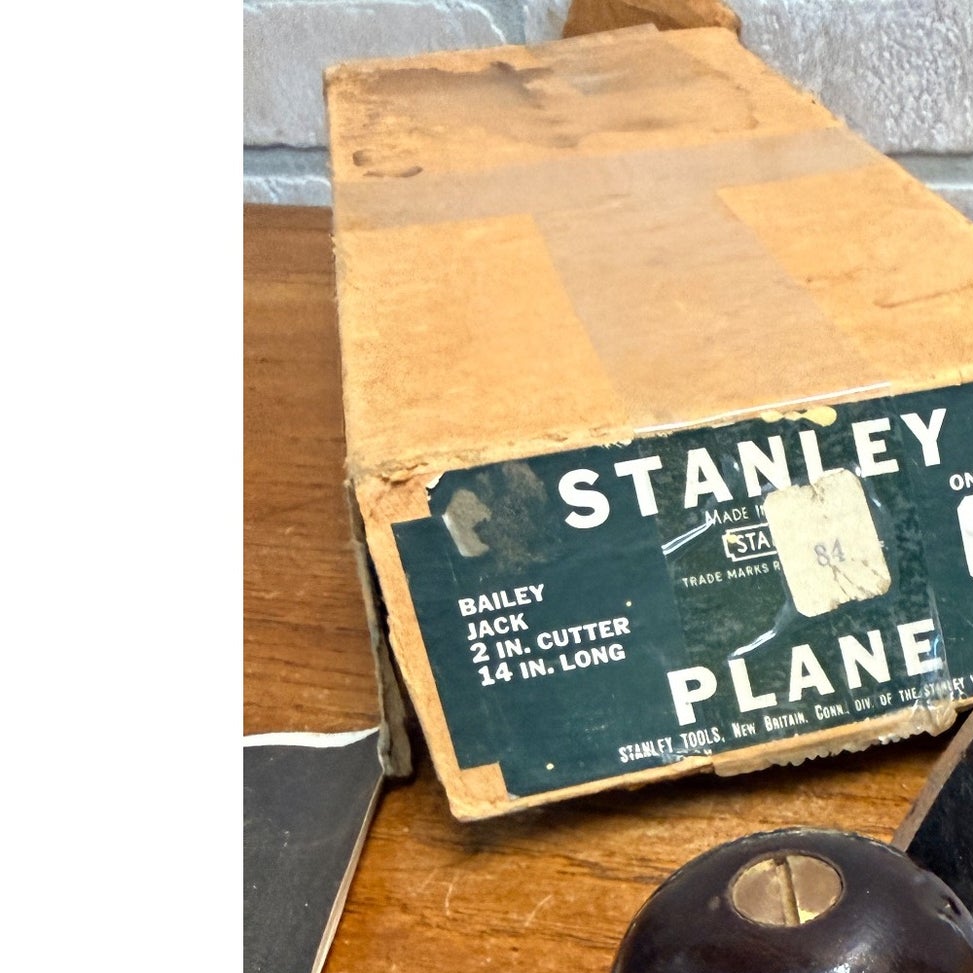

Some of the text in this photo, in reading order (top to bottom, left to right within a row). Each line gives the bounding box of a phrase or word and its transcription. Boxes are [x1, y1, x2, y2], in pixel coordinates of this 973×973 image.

[558, 408, 947, 529] STANLEY
[704, 506, 749, 527] MADE
[814, 537, 846, 567] 84
[682, 570, 723, 588] TRADE
[727, 563, 770, 580] MARKS
[457, 583, 545, 617] BAILEY
[467, 612, 529, 641] JACK
[469, 617, 632, 664] 2 IN. CUTTER
[477, 643, 627, 687] 14 IN. LONG
[666, 618, 944, 727] PLANE
[618, 736, 674, 763] STANLEY
[680, 726, 726, 749] TOOLS,
[855, 697, 875, 712] DIV.
[880, 692, 893, 706] OF
[898, 687, 918, 702] THE
